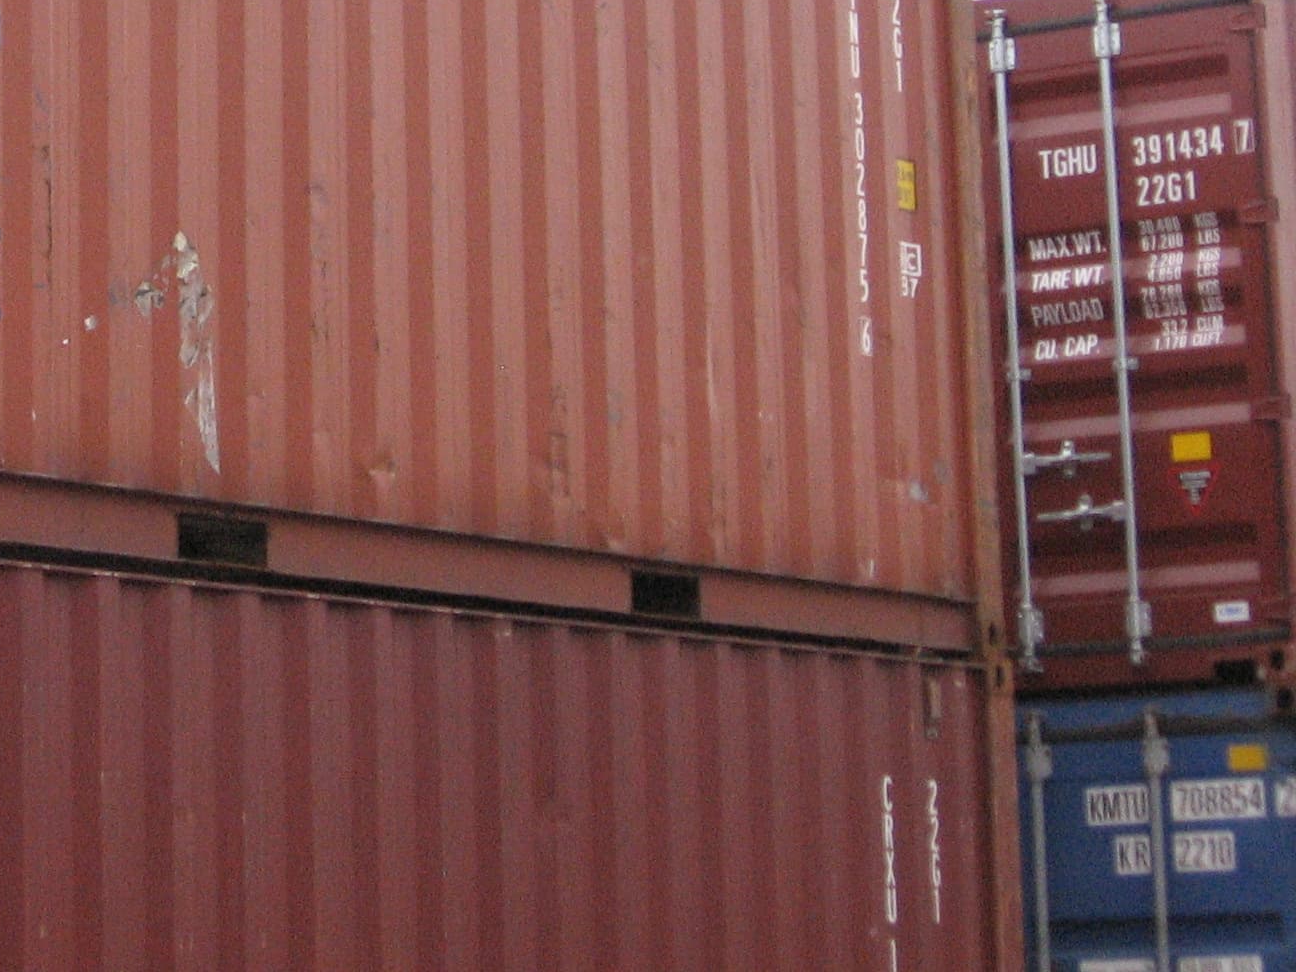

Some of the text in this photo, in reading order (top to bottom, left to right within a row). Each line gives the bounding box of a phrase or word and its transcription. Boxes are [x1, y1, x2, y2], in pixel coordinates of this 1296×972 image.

[1039, 120, 1252, 179] TGHU 391434 7
[854, 93, 870, 303] 302875
[1136, 171, 1197, 207] 22G1
[1194, 212, 1218, 229] KGS
[1197, 227, 1221, 246] LBS
[1030, 267, 1071, 293] TARE
[1197, 262, 1220, 278] LBS
[1030, 298, 1105, 328] PAYLOAD
[1034, 340, 1058, 360] CU.
[1196, 315, 1224, 332] CUM
[1088, 789, 1148, 821] KMTU
[883, 776, 897, 923] CRXU
[929, 779, 941, 925] 22G1
